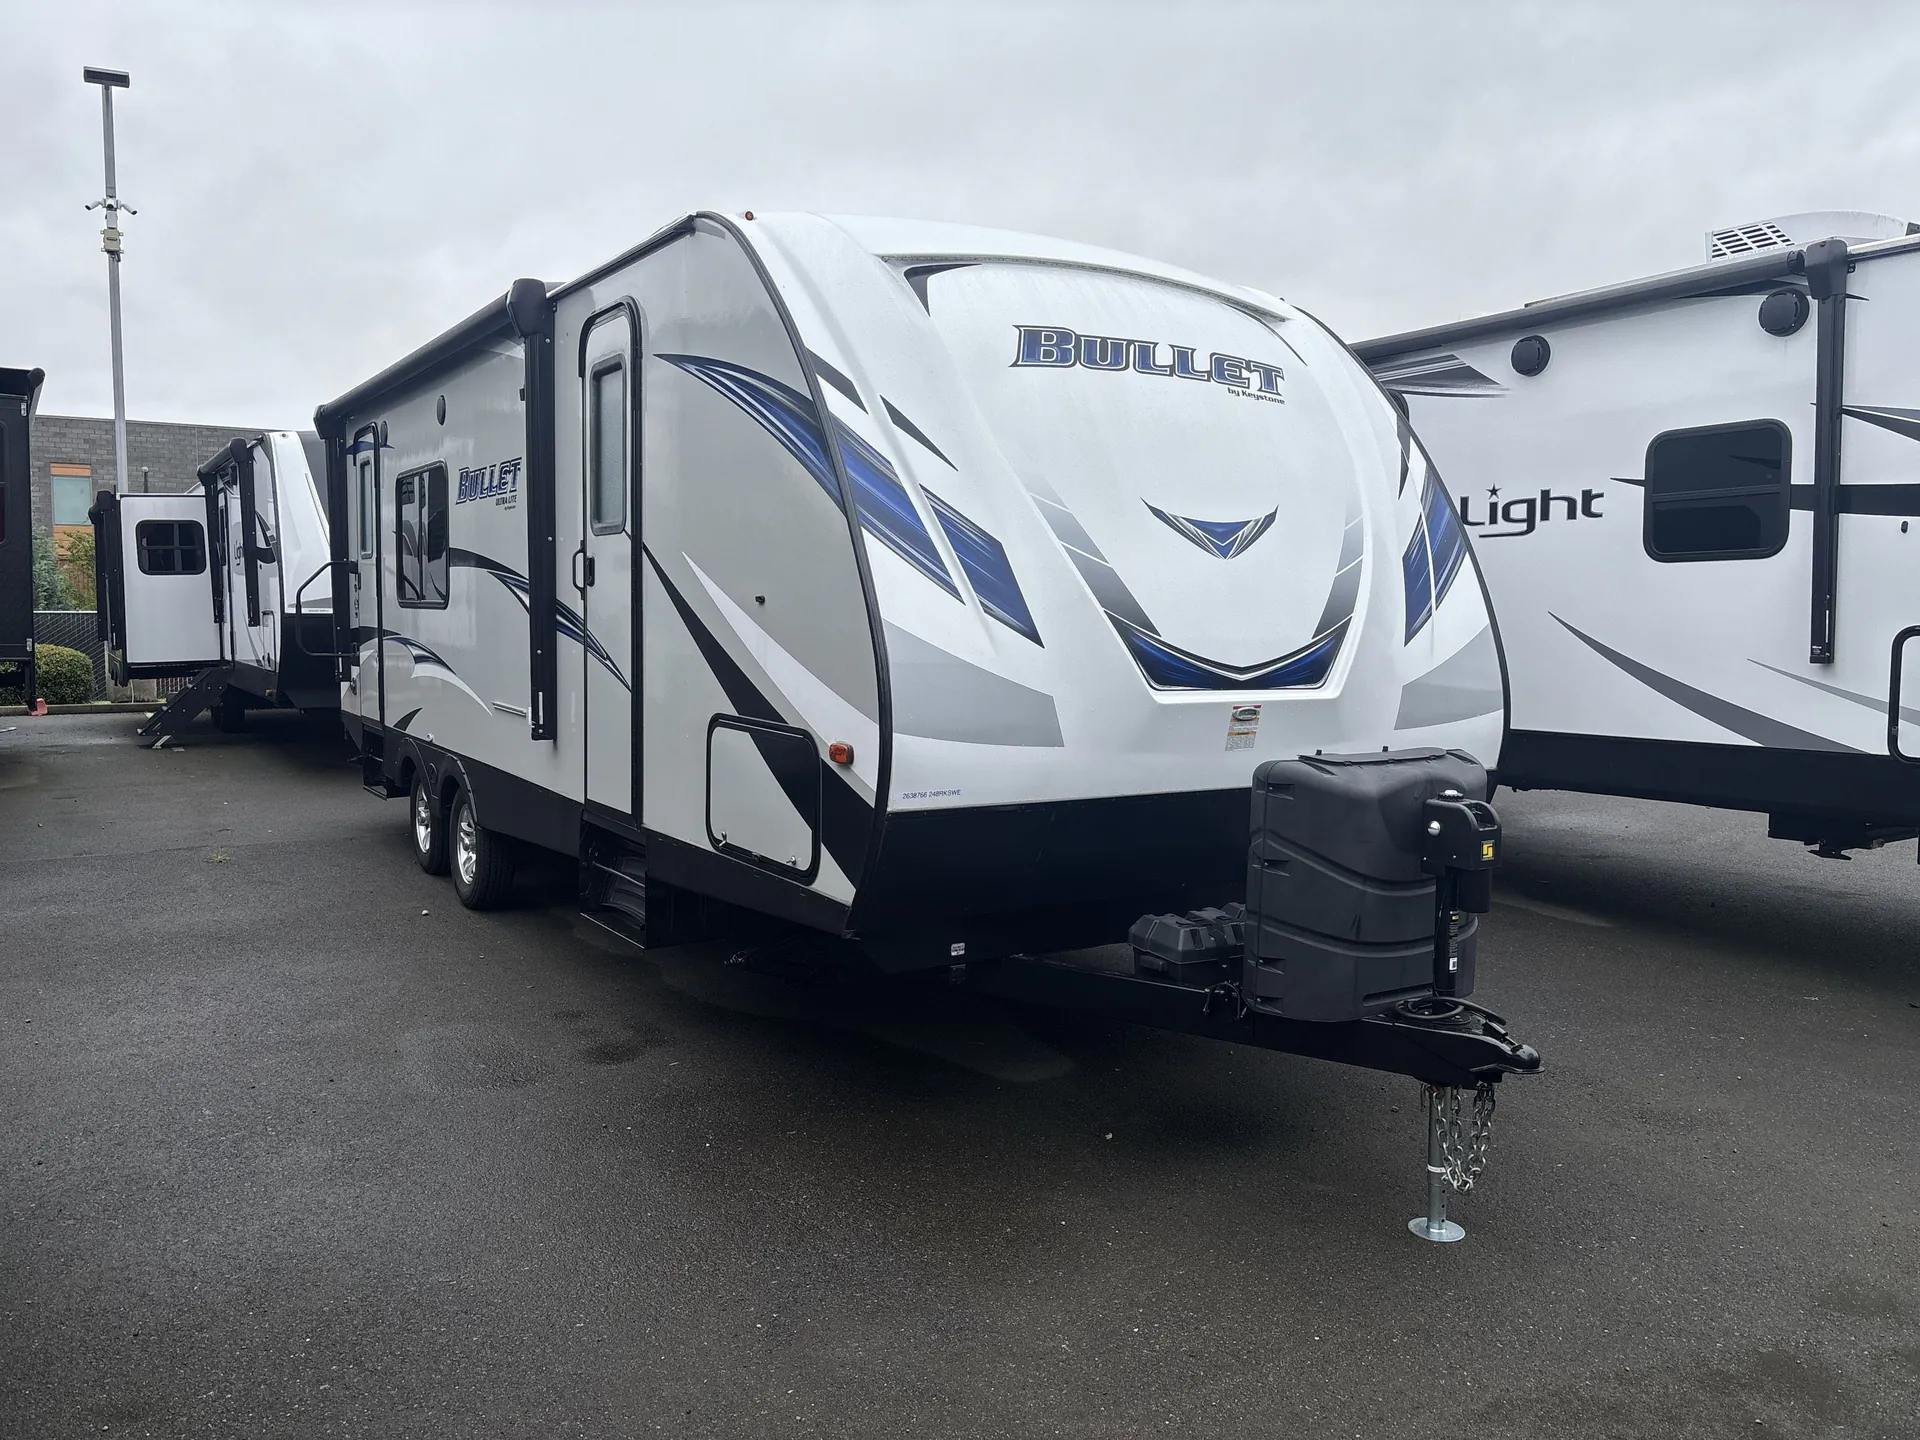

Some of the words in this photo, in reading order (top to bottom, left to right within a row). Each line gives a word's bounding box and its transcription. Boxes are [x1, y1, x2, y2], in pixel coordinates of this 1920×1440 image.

[1008, 324, 1285, 397] BULLET
[1227, 387, 1240, 397] by
[1241, 389, 1286, 405] Keystone
[455, 456, 522, 505] BULLET
[1459, 483, 1605, 538] Light
